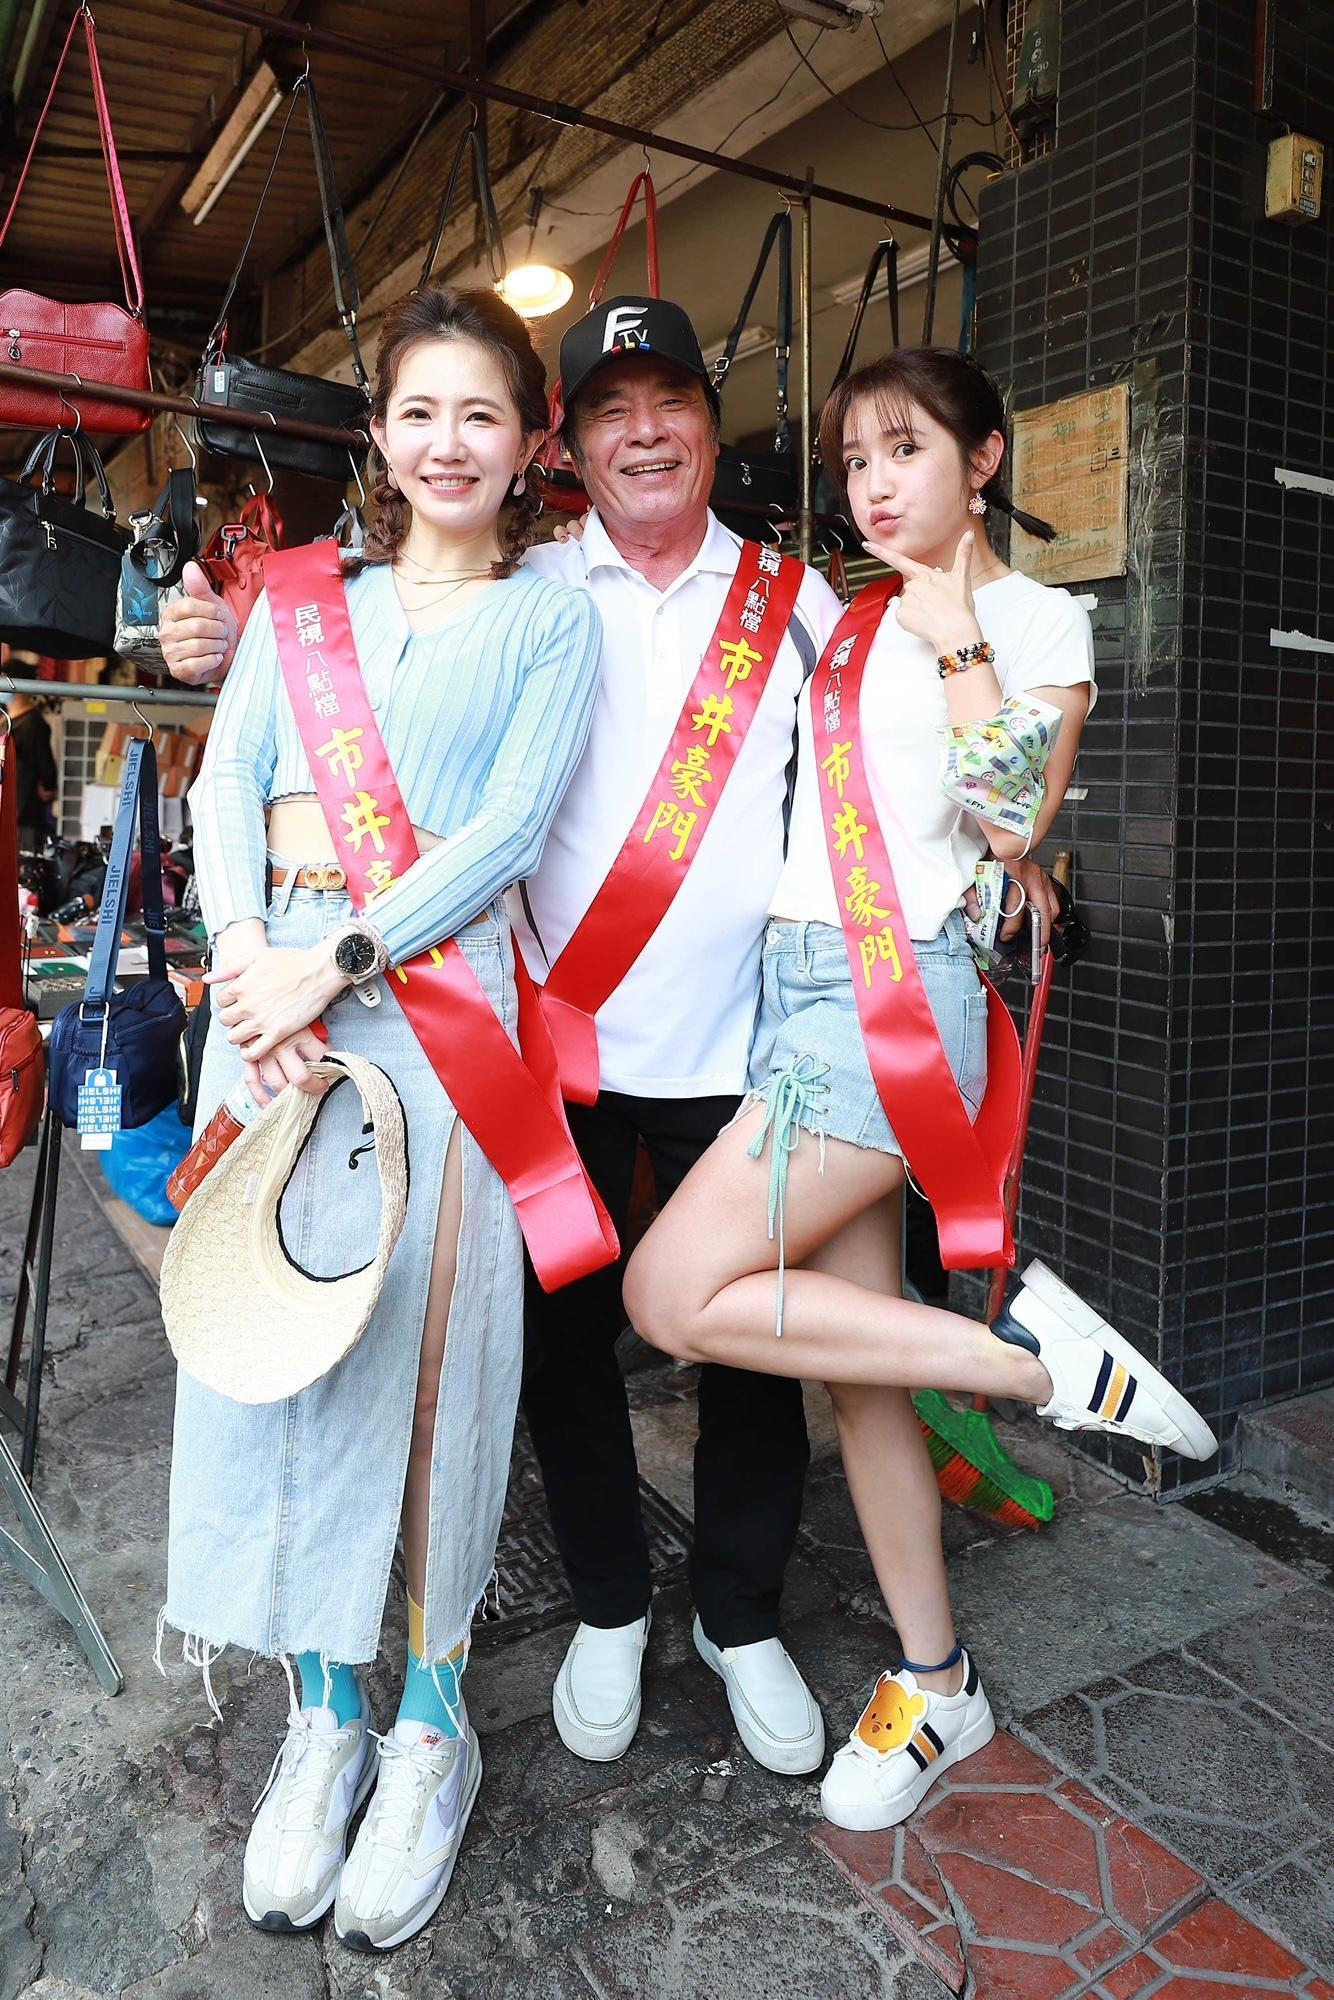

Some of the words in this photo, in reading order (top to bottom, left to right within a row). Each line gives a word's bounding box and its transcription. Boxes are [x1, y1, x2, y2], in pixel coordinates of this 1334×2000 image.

[602, 305, 648, 353] FTV
[294, 603, 325, 648] 民視
[739, 576, 770, 634] 八點檔
[304, 650, 341, 721] 八點檔
[823, 672, 842, 736] 八點檔
[122, 749, 138, 806] JIELSHI
[643, 636, 763, 862] 市井豪門
[970, 800, 986, 811] FTV
[821, 741, 904, 990] 市井豪門
[101, 865, 120, 924] JIELSHI
[78, 1087, 120, 1096] JIELSHI
[78, 1105, 120, 1114] JIELSHI
[77, 1124, 120, 1133] JIELSHI
